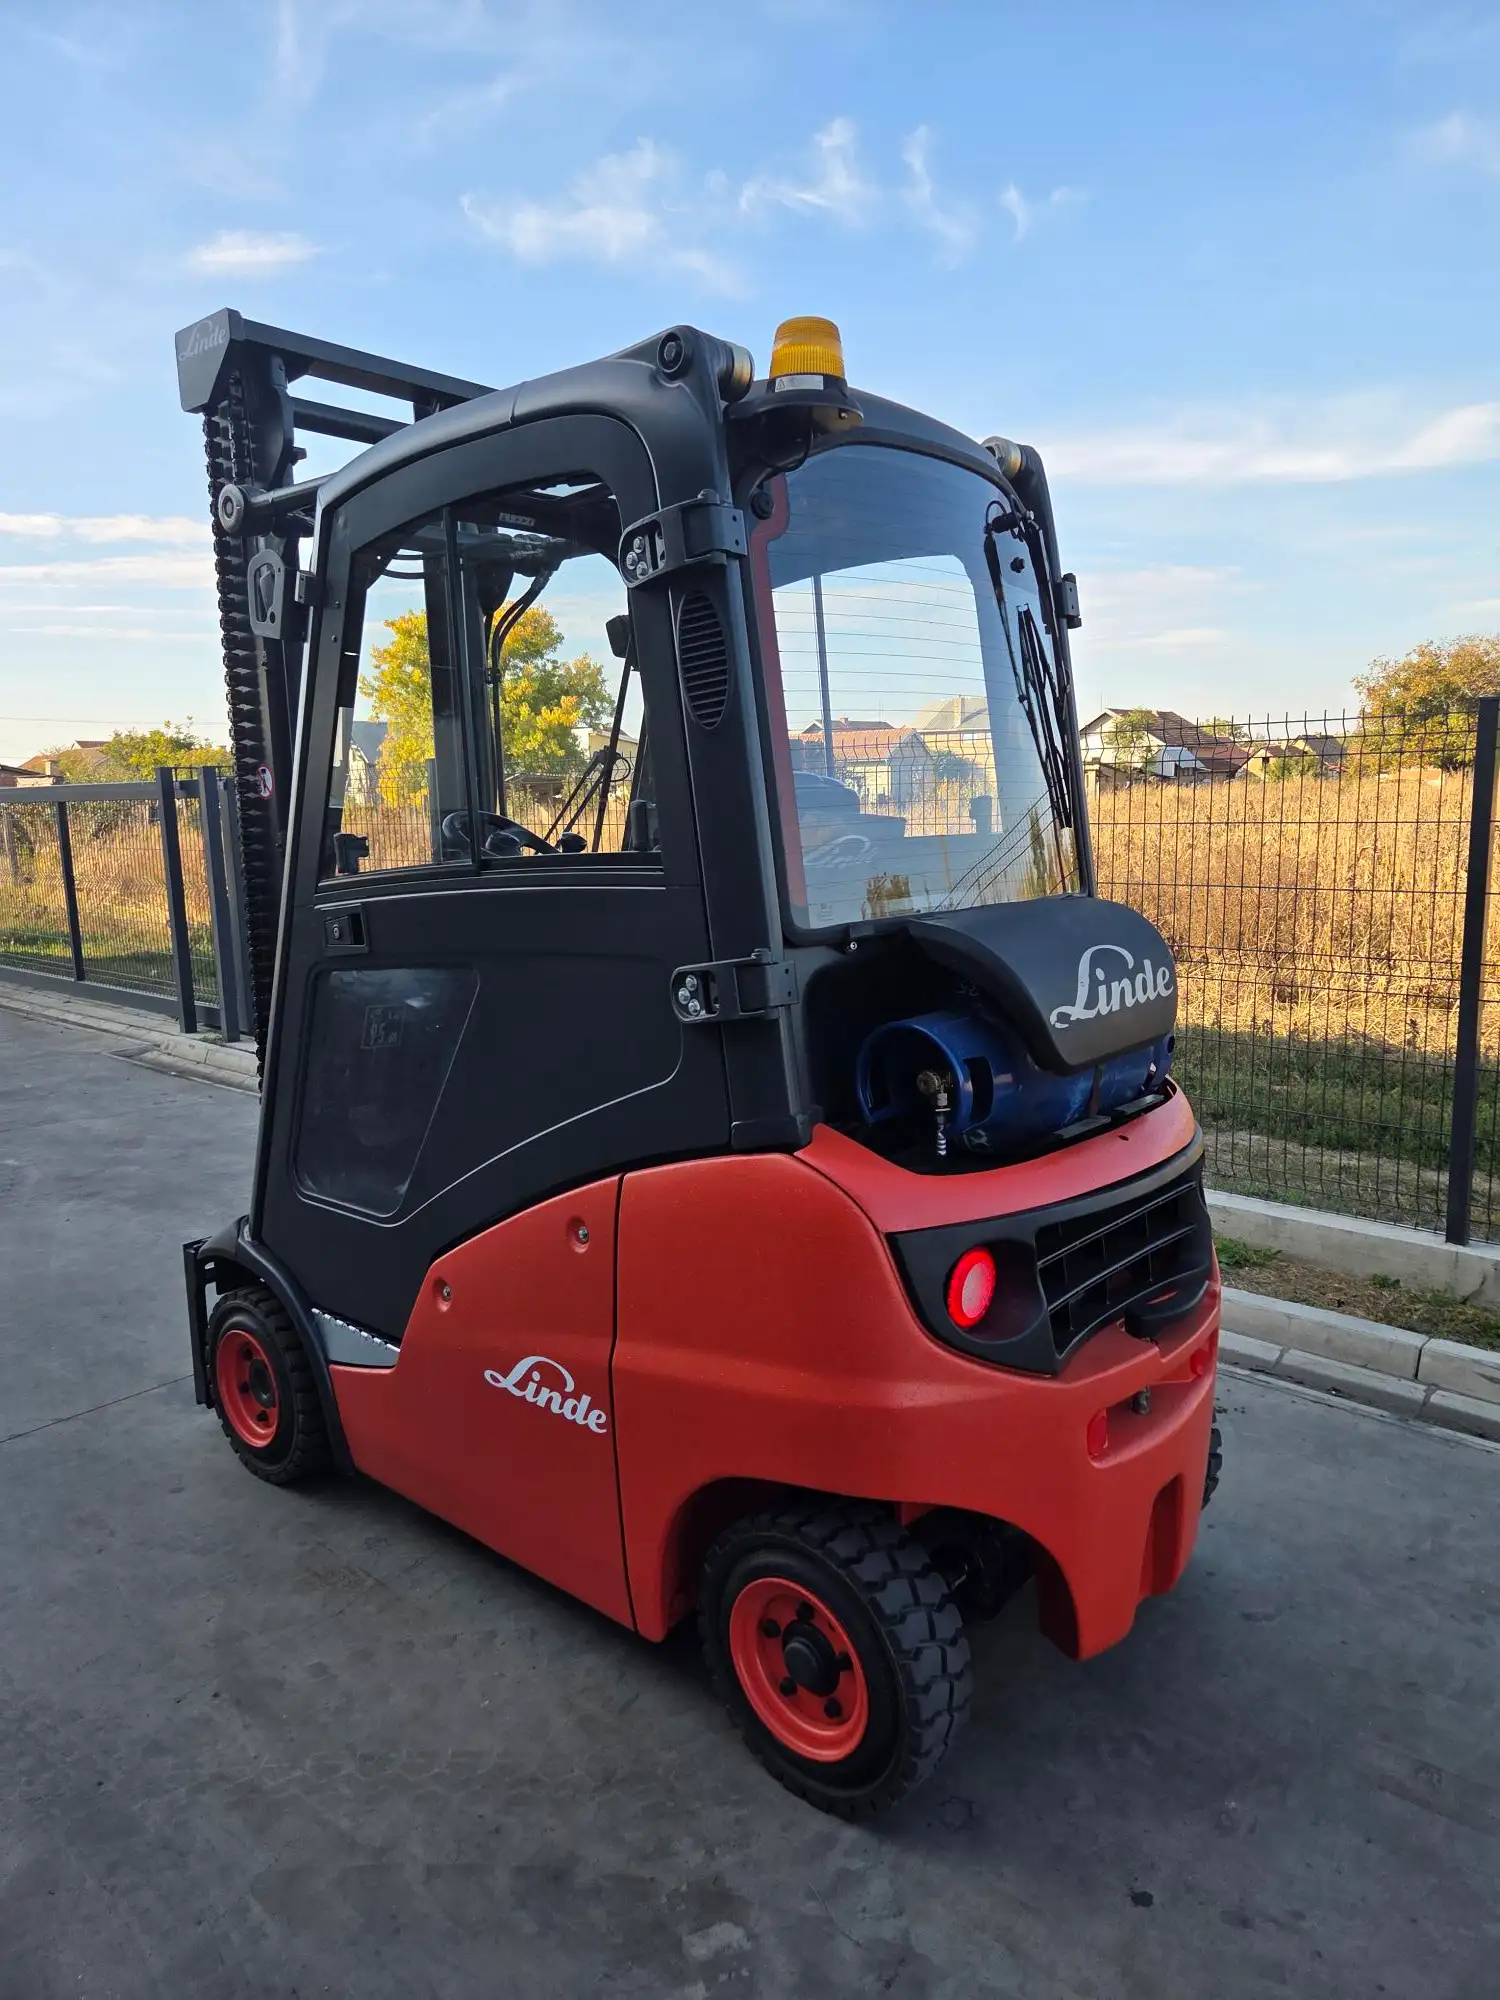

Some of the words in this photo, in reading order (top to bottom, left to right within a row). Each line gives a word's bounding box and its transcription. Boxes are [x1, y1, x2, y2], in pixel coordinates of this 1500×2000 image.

[178, 319, 226, 361] Linde
[1049, 944, 1174, 1029] Linde
[484, 1355, 607, 1433] Linde
